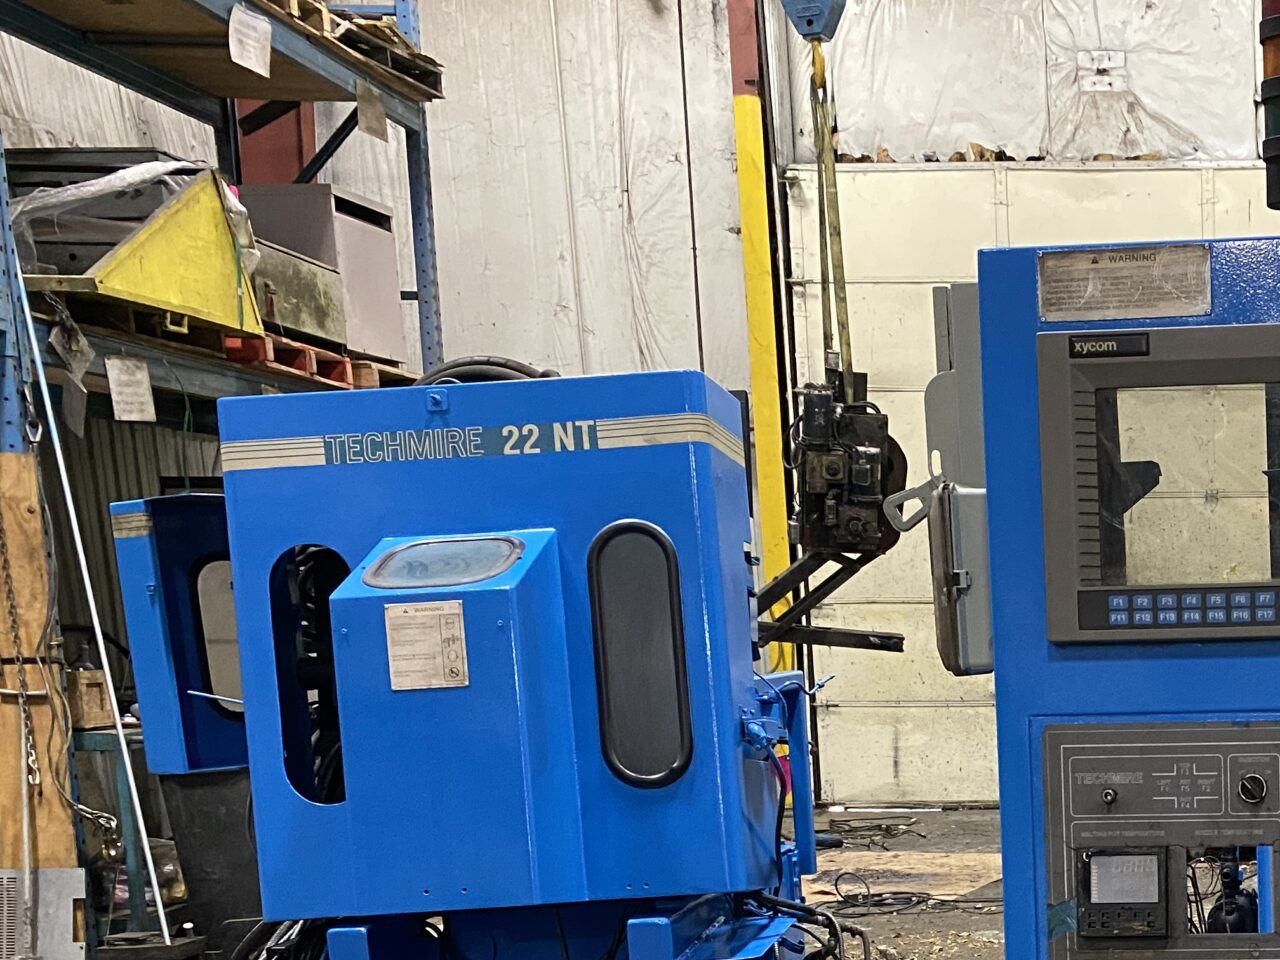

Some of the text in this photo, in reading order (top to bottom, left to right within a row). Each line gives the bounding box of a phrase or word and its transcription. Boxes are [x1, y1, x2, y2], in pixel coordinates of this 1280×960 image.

[1108, 253, 1157, 263] WARNING
[1074, 340, 1117, 354] xycom
[325, 419, 595, 465] TECHMIRE 22 NT
